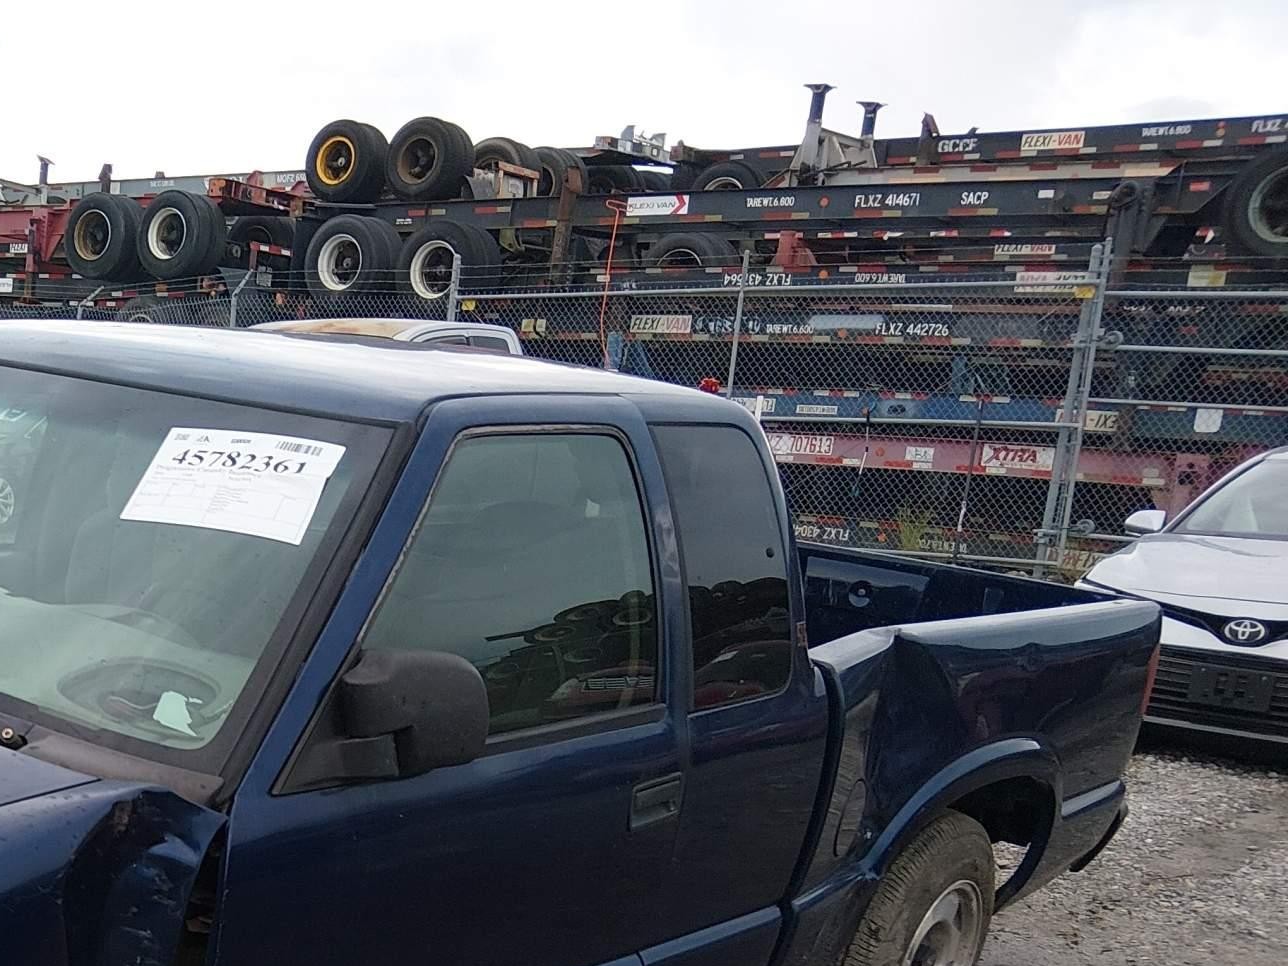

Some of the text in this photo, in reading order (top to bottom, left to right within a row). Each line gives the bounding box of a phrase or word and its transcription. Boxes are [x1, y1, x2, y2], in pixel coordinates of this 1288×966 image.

[1023, 133, 1083, 148] FLEXI-VAN
[855, 193, 920, 208] FLXZ 414671
[961, 191, 989, 205] SACP
[766, 273, 792, 286] FLXZ
[906, 323, 949, 337] 442726
[790, 435, 833, 454] 707613
[172, 448, 307, 474] 45782361
